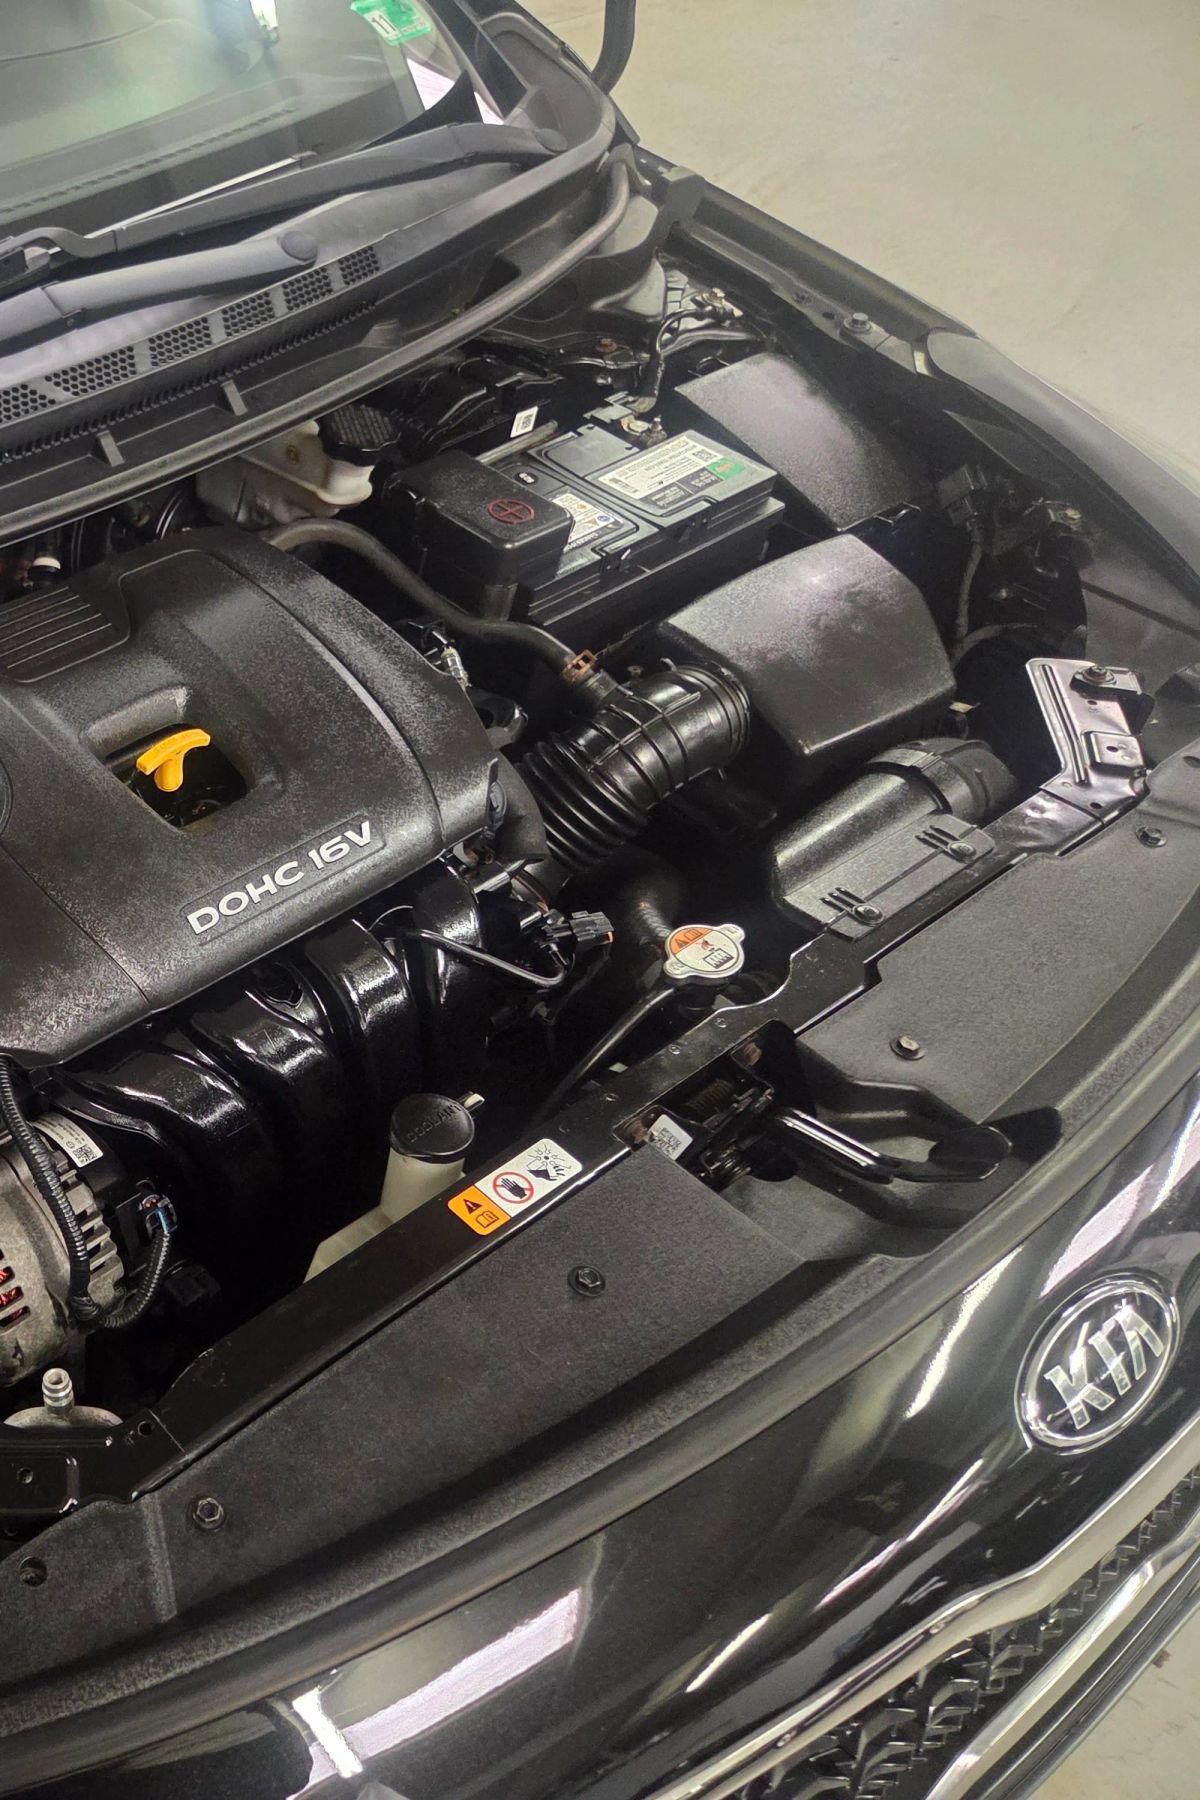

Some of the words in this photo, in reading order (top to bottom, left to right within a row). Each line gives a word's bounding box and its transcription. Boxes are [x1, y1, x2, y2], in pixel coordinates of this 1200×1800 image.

[186, 860, 305, 935] DOHC
[307, 820, 371, 870] 16V
[406, 1104, 462, 1143] COOLANT
[1043, 1303, 1165, 1431] KIA
